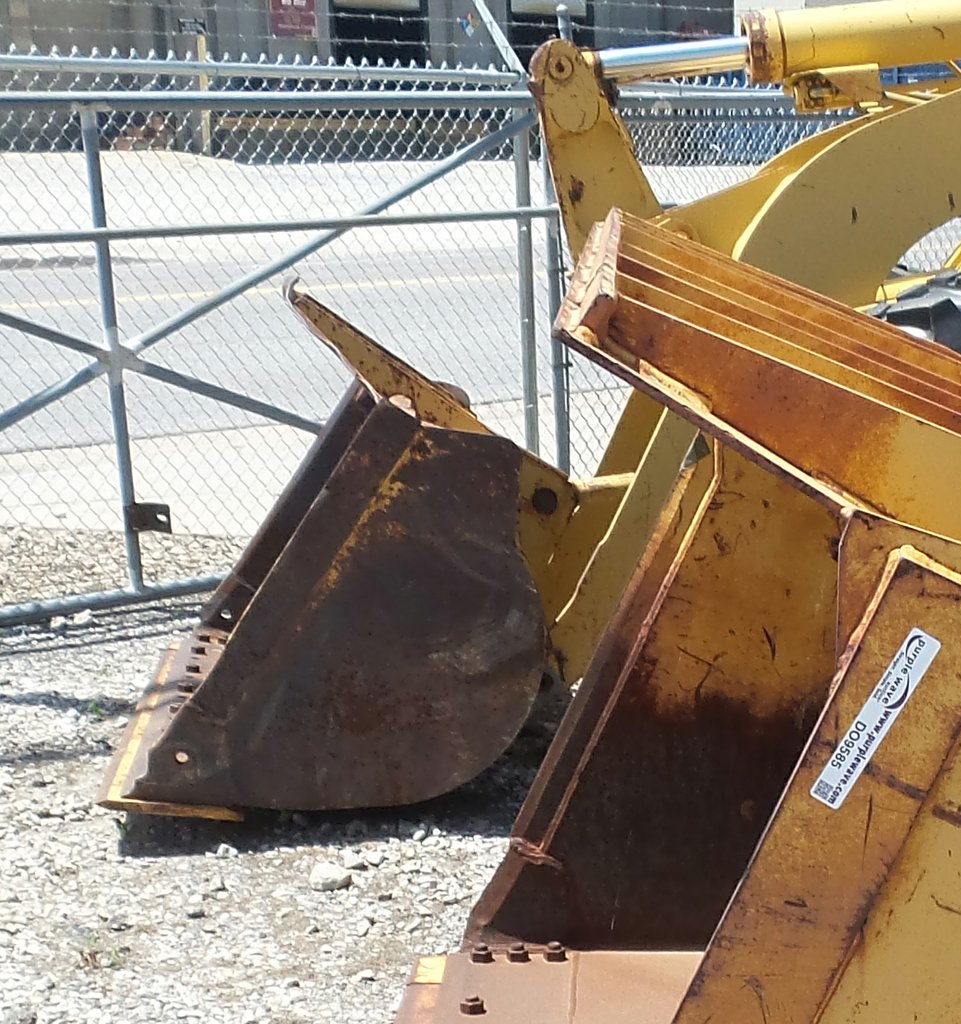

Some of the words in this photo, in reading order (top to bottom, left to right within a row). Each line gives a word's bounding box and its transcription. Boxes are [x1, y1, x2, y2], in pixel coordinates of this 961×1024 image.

[900, 638, 926, 675] purple
[882, 677, 904, 705] wave
[827, 710, 892, 805] www.purplewave.com
